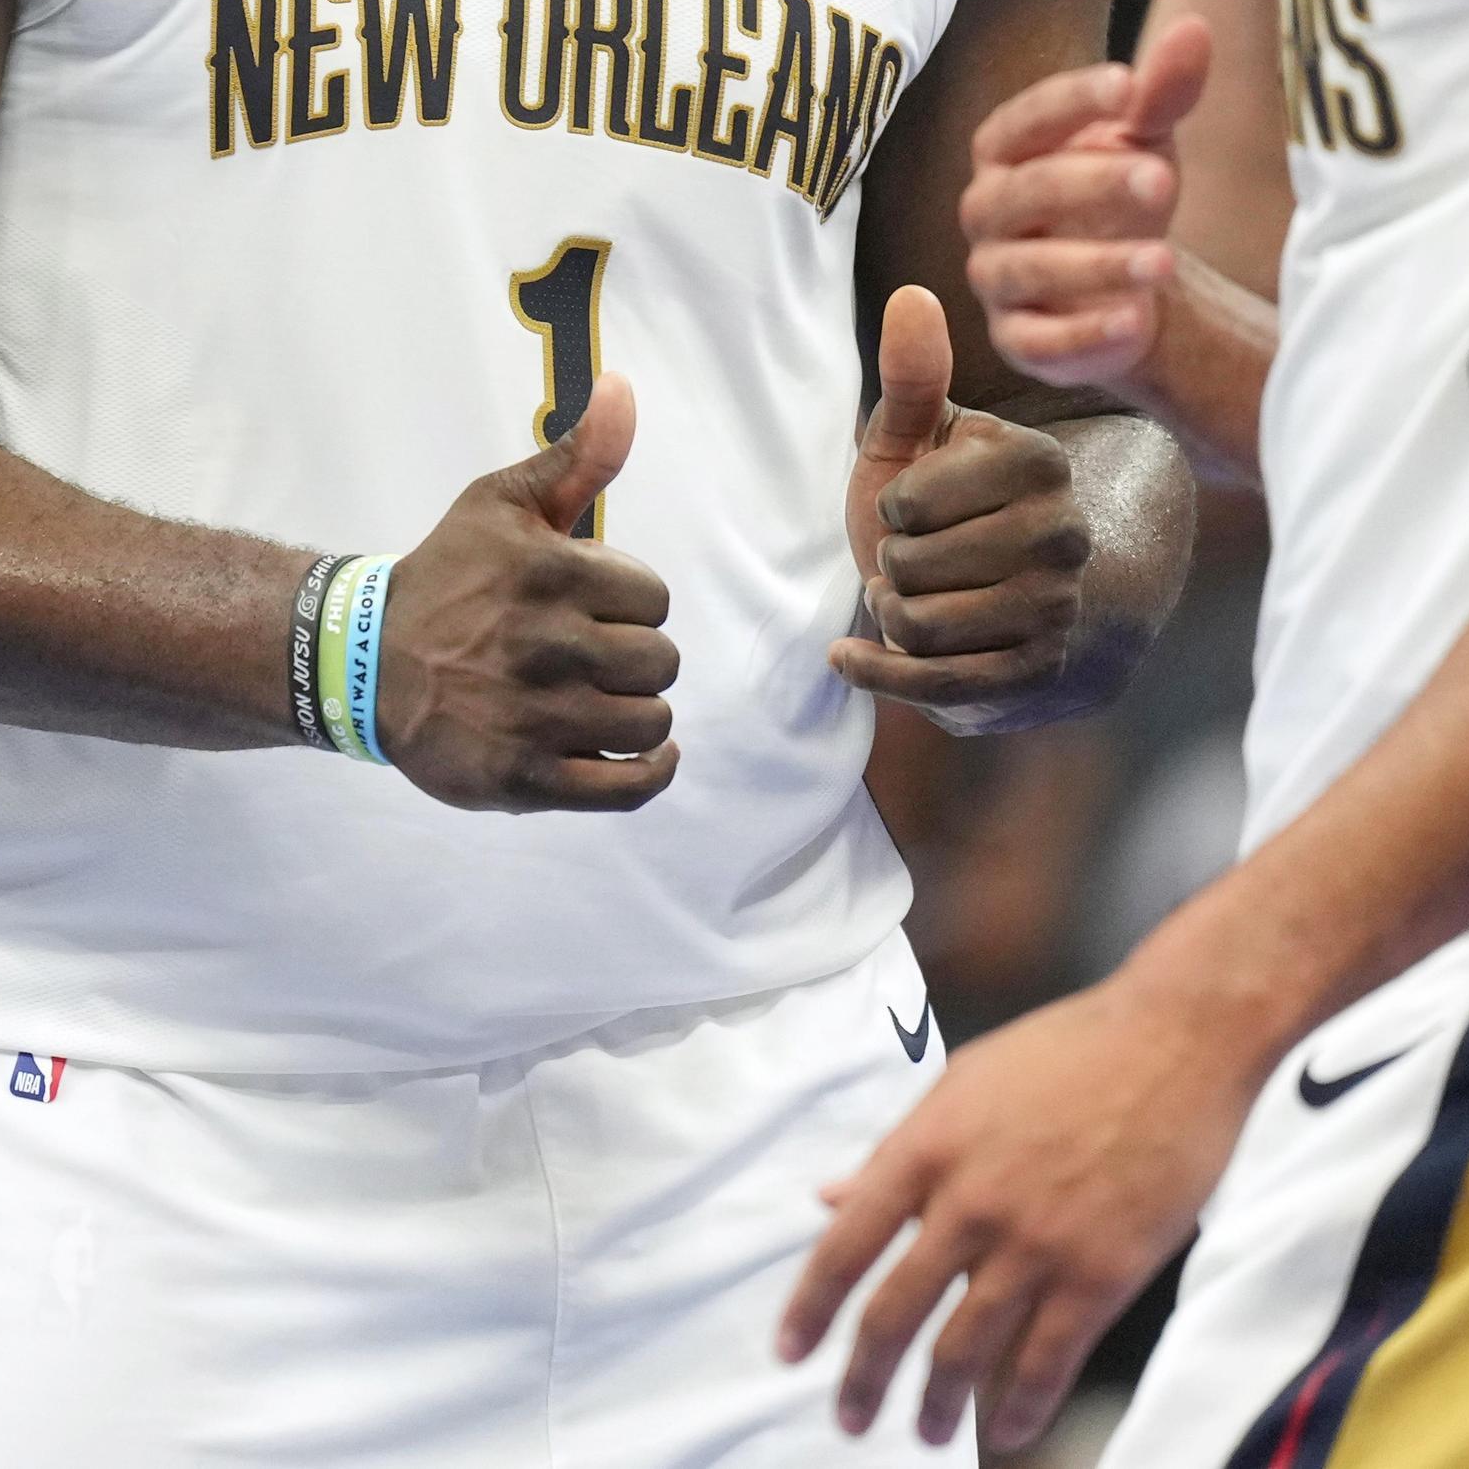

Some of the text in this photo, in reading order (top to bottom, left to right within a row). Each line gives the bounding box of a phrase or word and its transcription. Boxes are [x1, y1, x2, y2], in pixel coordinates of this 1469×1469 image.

[509, 235, 613, 546] 1
[293, 625, 311, 691] JUTSU
[355, 639, 369, 652] A
[353, 658, 367, 701] WAS
[14, 1071, 41, 1095] NBA
